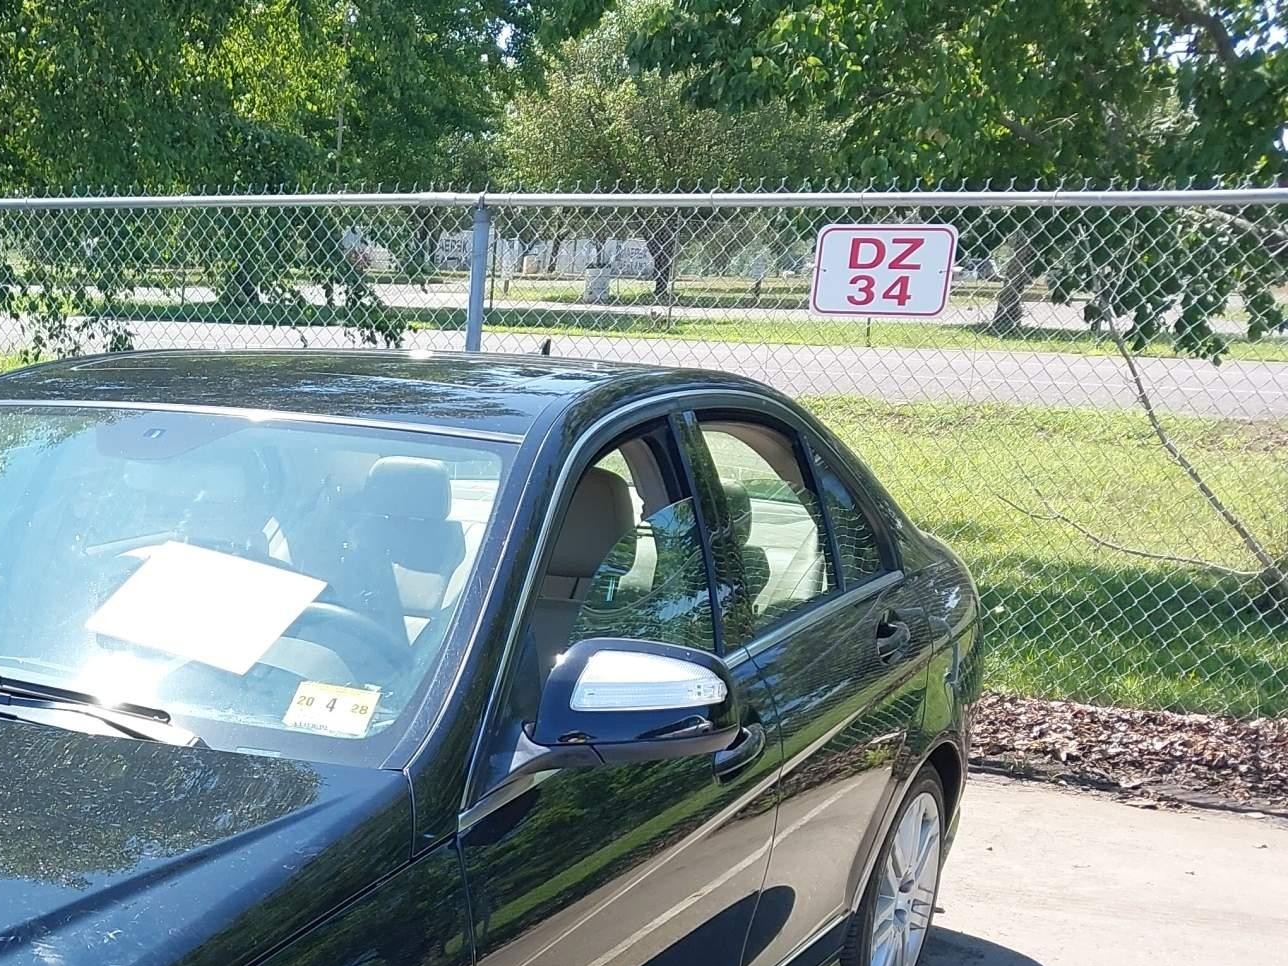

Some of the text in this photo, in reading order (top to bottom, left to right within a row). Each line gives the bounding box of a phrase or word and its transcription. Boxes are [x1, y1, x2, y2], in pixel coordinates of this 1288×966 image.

[848, 237, 925, 270] DZ
[846, 274, 912, 306] 34
[296, 695, 315, 707] 20
[325, 697, 338, 713] 4
